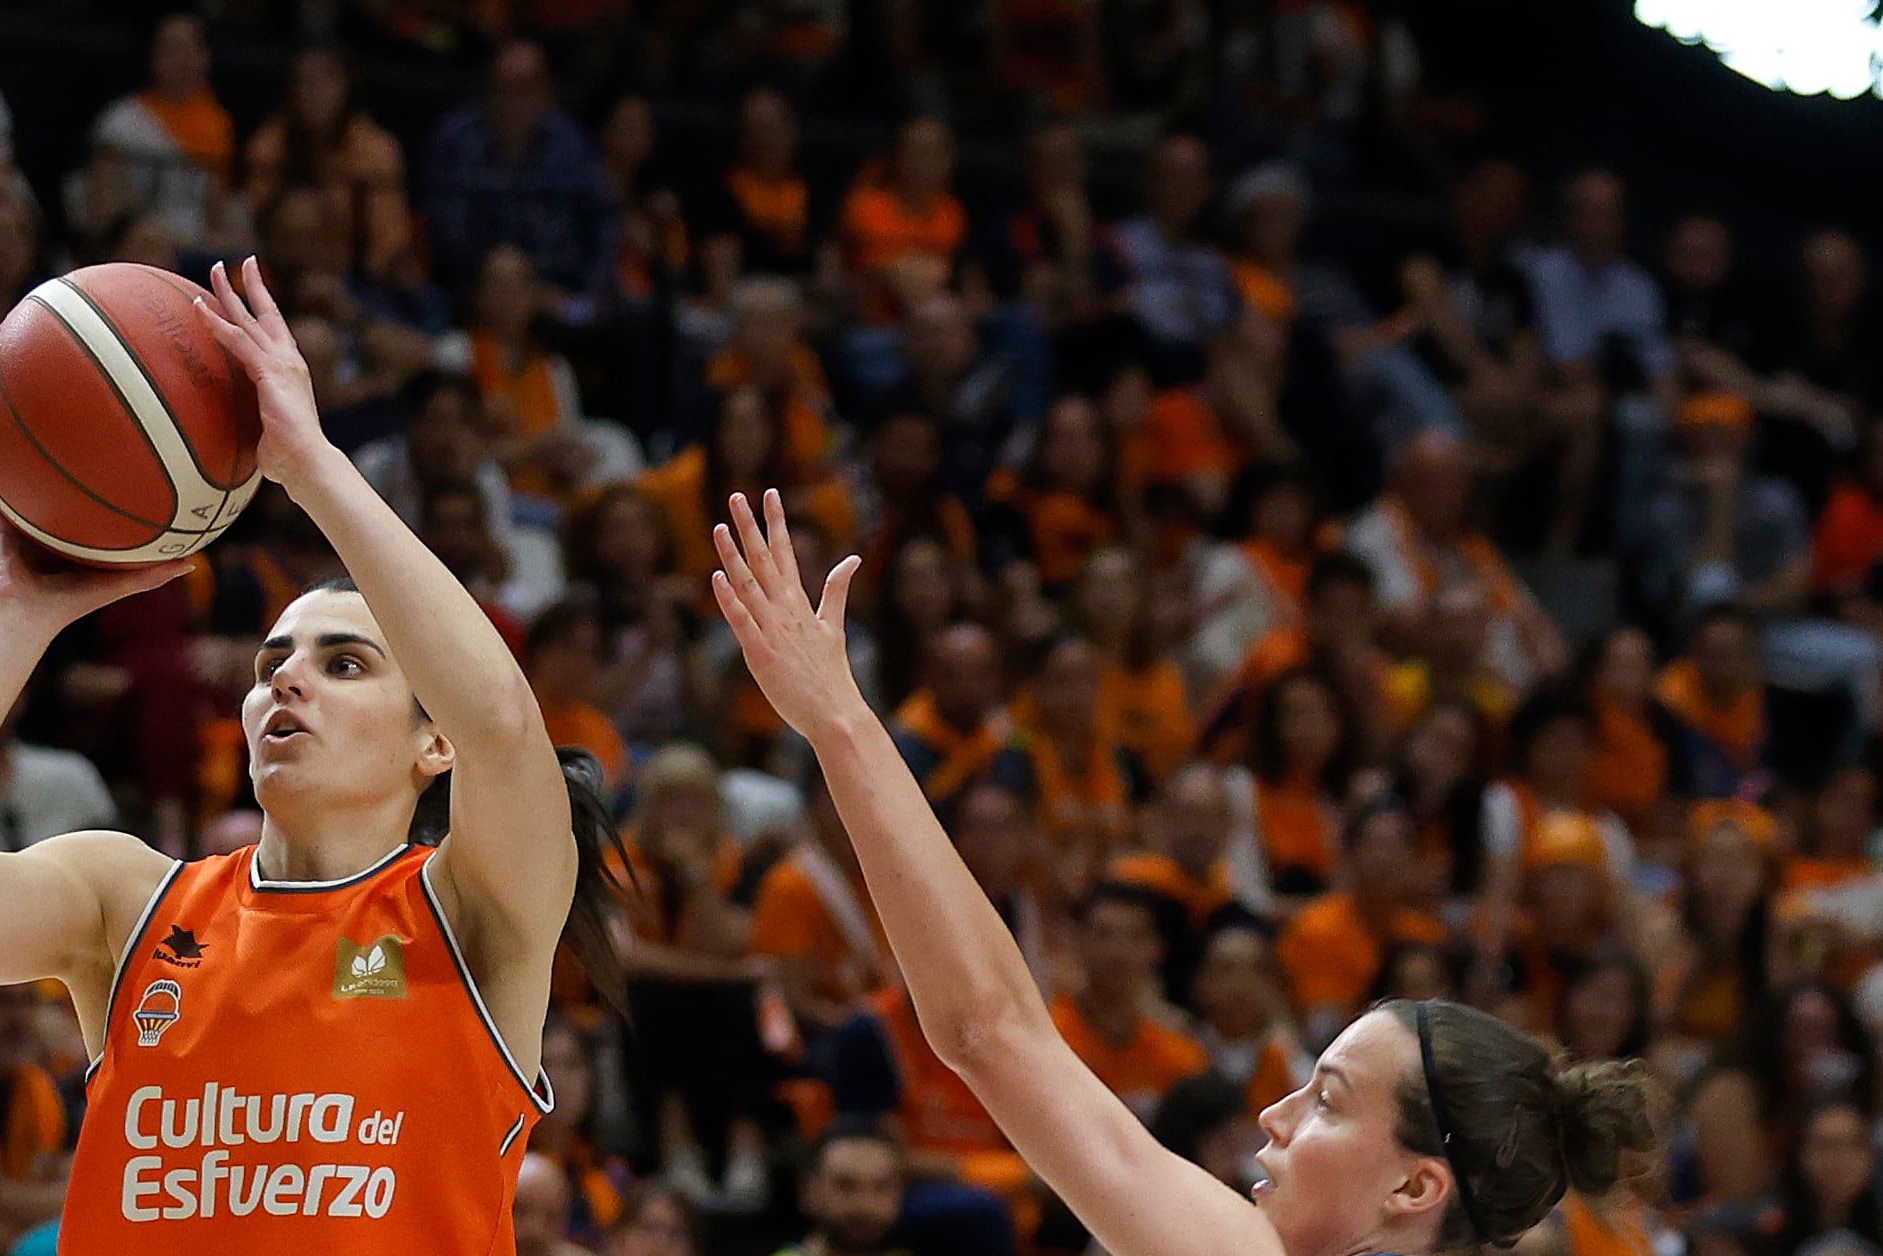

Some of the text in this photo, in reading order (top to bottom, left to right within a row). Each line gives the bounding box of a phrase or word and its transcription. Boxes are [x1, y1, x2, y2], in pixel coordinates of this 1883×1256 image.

[124, 1082, 405, 1150] Cultura del
[121, 1150, 396, 1222] Esfuerzo
